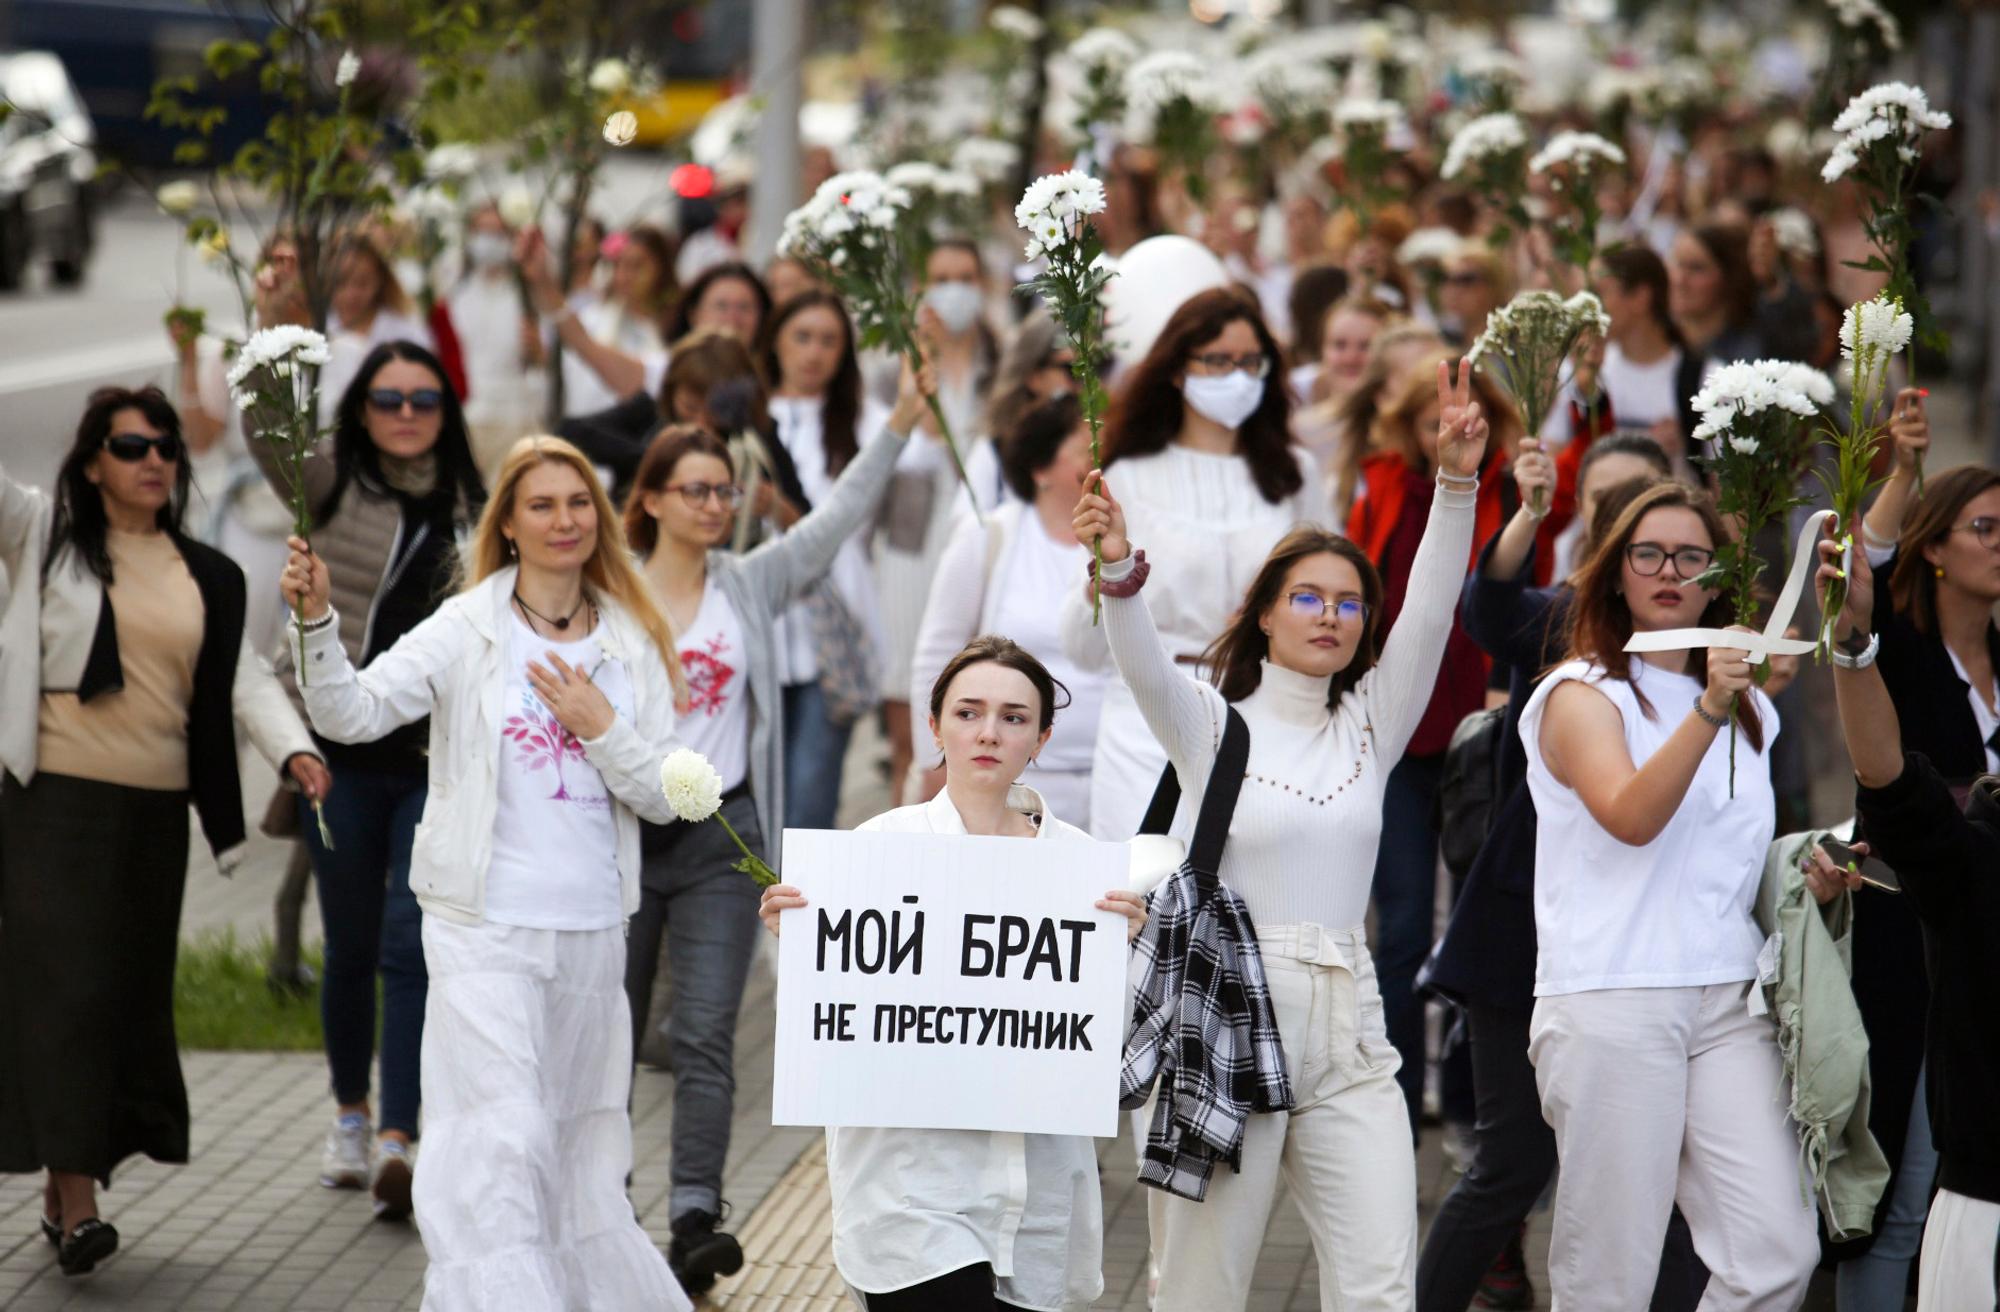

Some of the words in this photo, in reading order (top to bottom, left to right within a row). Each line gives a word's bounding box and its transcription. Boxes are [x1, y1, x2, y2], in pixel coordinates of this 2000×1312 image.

[816, 895, 925, 975] МОЙ
[960, 913, 1097, 983] БРАТ
[813, 1002, 857, 1042] НЕ
[873, 1004, 1095, 1052] ПРЕСТУПНИК
